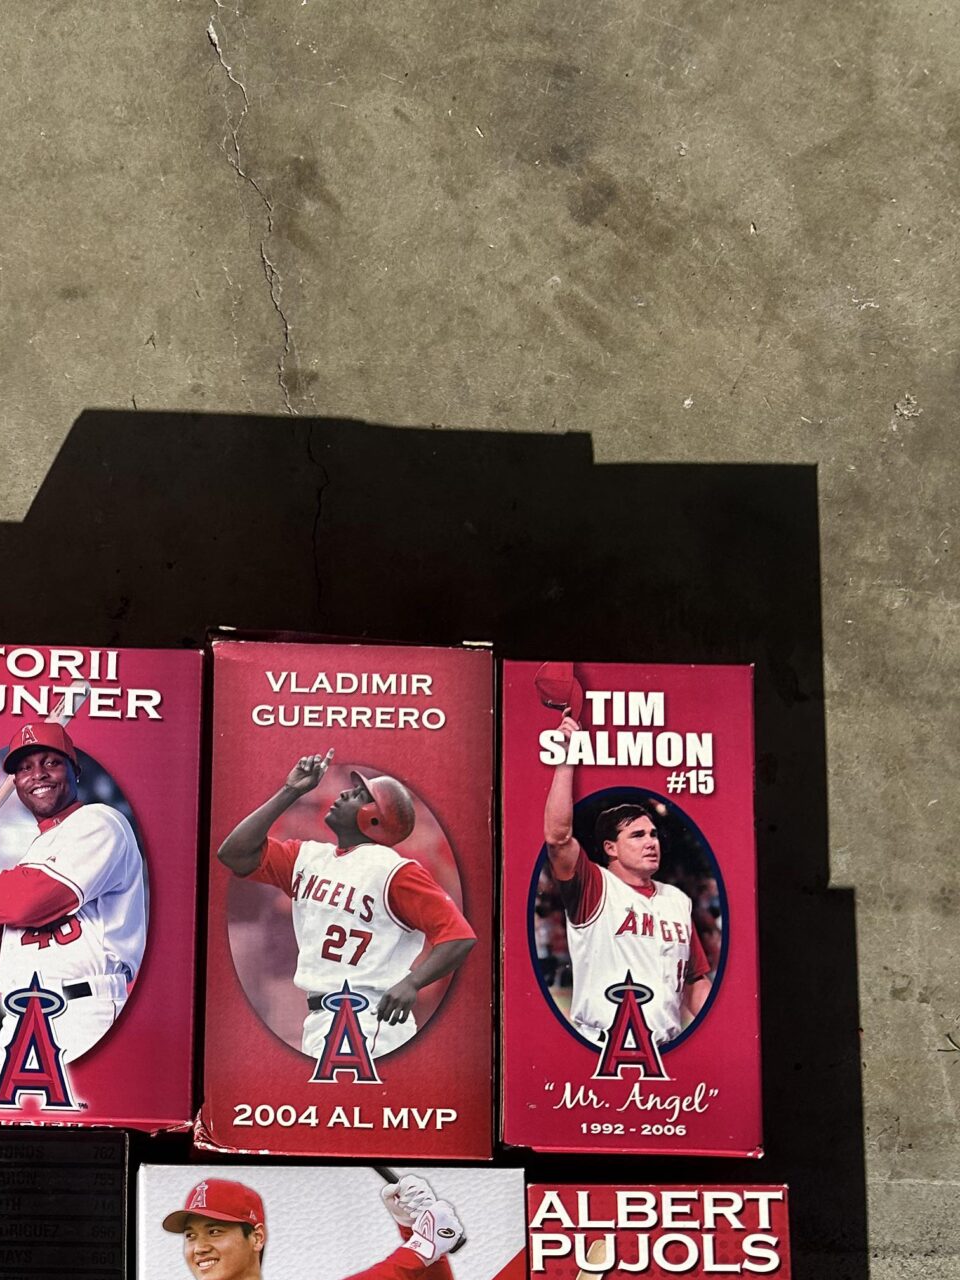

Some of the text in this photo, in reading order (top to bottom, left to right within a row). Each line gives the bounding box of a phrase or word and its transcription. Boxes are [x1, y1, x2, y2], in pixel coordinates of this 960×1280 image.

[265, 671, 433, 696] VLADIMIR
[251, 704, 446, 730] GUERRERO
[586, 690, 665, 727] TIM
[539, 729, 714, 768] SALMON
[666, 769, 715, 795] #15
[291, 868, 375, 923] ANGELS
[321, 924, 373, 967] 27
[233, 1104, 458, 1131] 2004 AL MVP
[580, 1123, 625, 1135] 1992
[641, 1123, 687, 1136] 2006
[528, 1190, 784, 1230] ALBERT
[529, 1232, 783, 1274] PUJOLS
